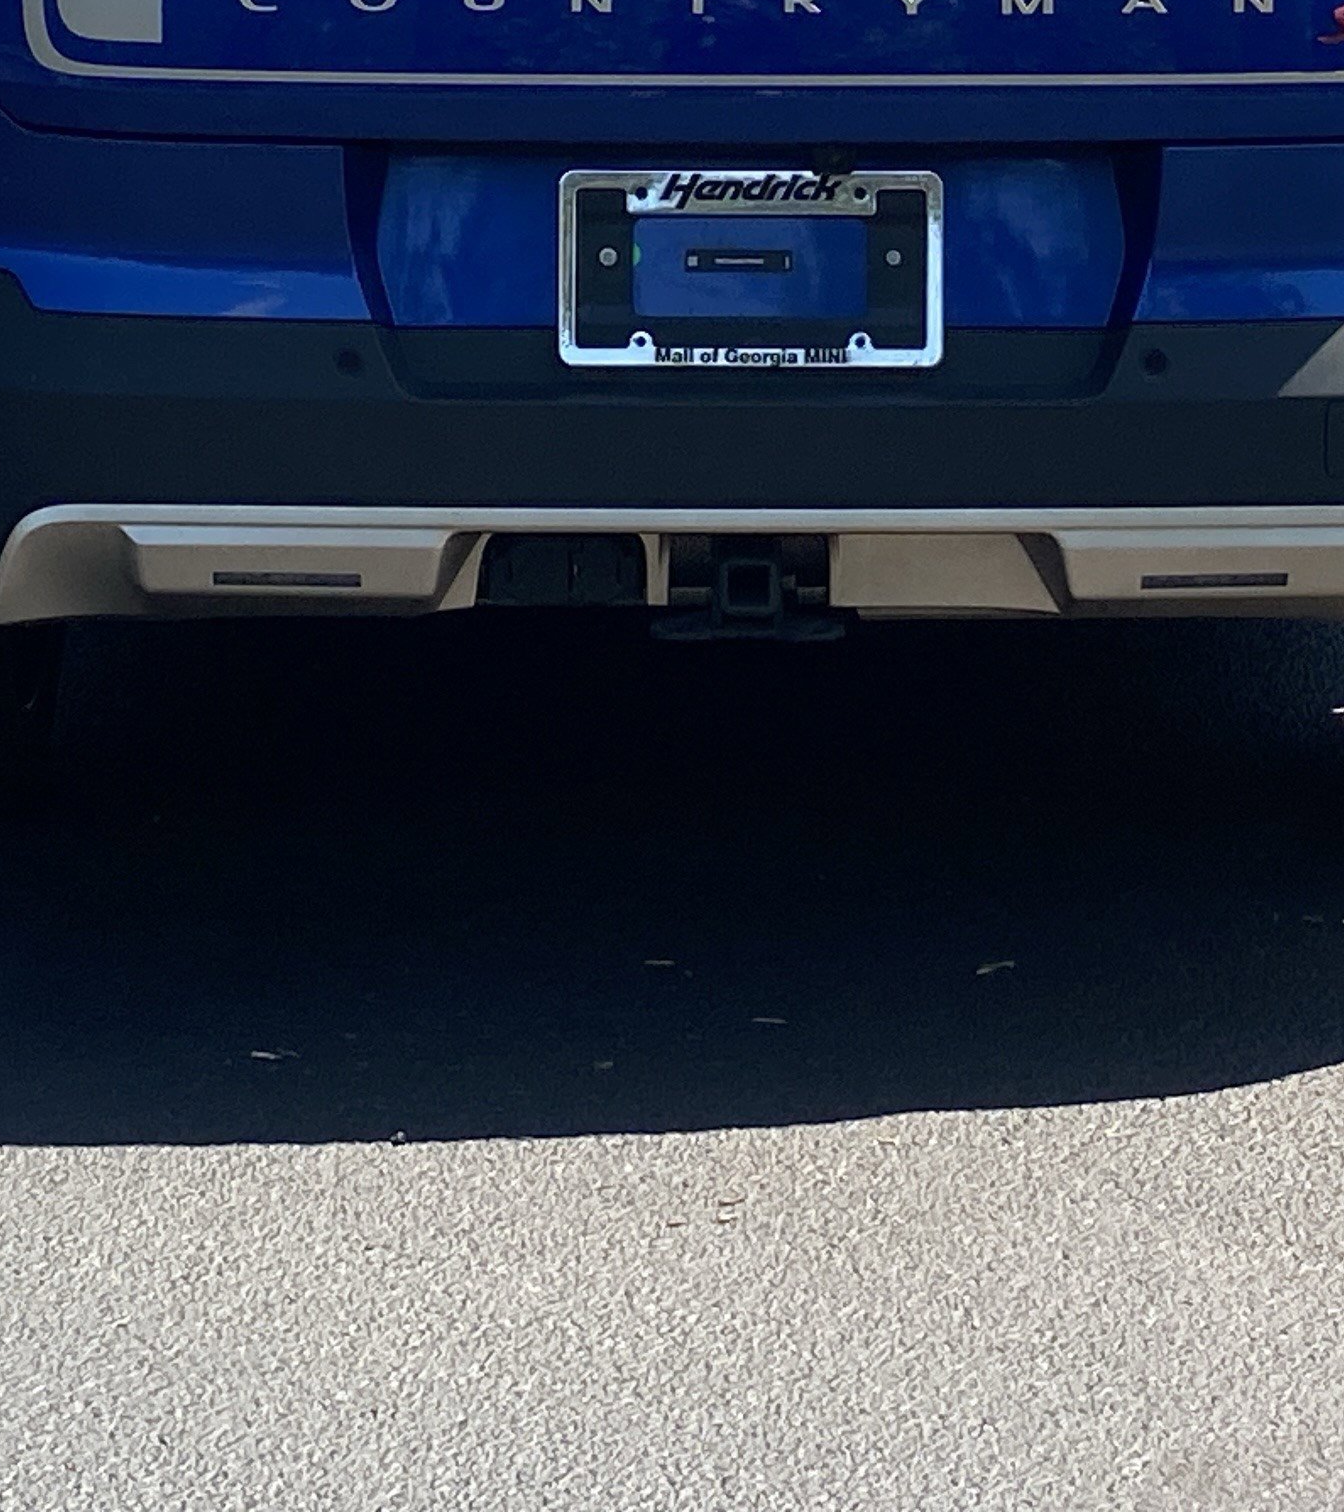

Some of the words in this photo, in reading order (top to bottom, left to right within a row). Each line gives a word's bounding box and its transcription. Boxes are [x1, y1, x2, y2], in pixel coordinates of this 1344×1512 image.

[659, 173, 842, 210] Hendrick
[655, 347, 694, 364] Mall
[700, 347, 718, 364] of
[724, 347, 798, 367] Georgia
[804, 347, 847, 365] MINI
